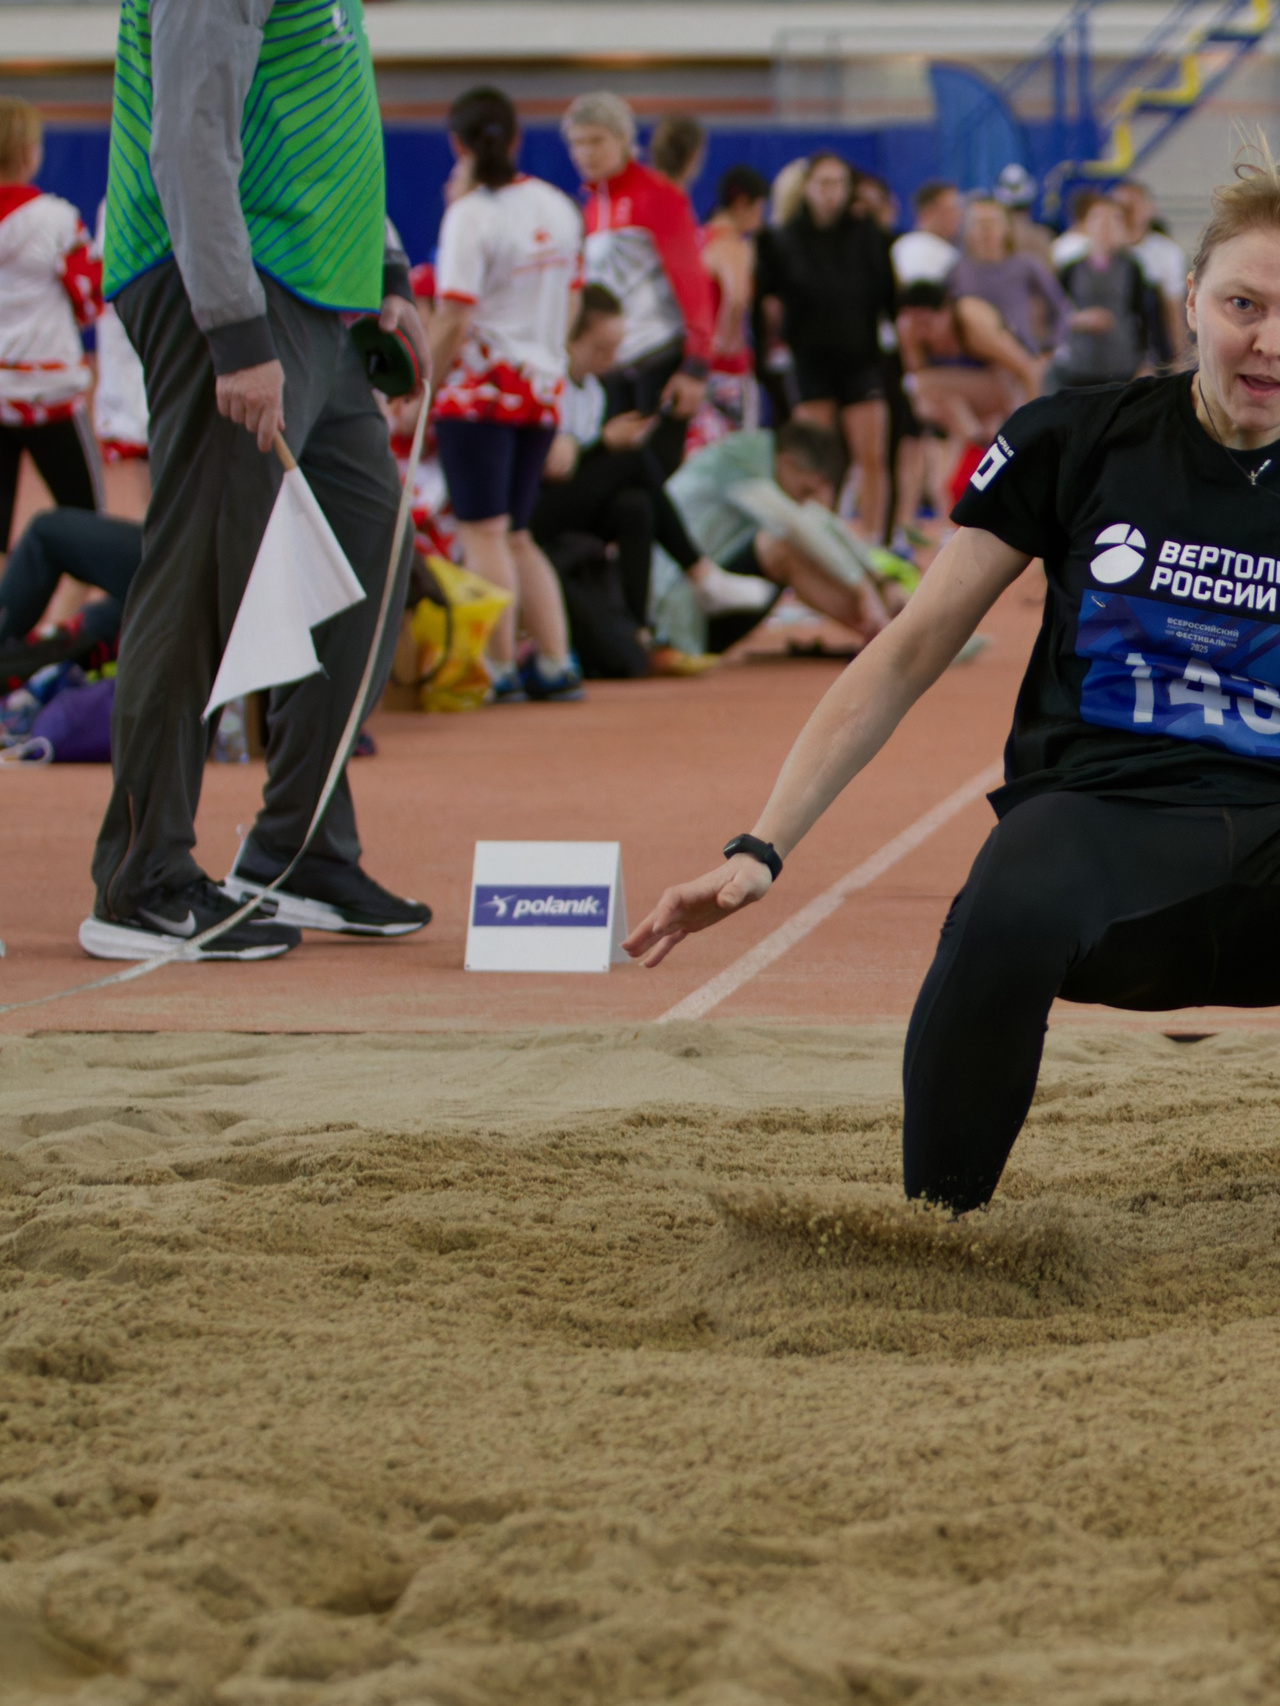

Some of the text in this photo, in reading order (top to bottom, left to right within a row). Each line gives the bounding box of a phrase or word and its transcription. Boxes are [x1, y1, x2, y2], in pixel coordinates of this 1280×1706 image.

[1150, 565, 1277, 612] РОССИИ
[1166, 617, 1239, 637] ВСЕРОССИЙСКИЙ
[1175, 631, 1227, 647] ФЕСТИВАЛЬ
[512, 895, 600, 919] polanik
